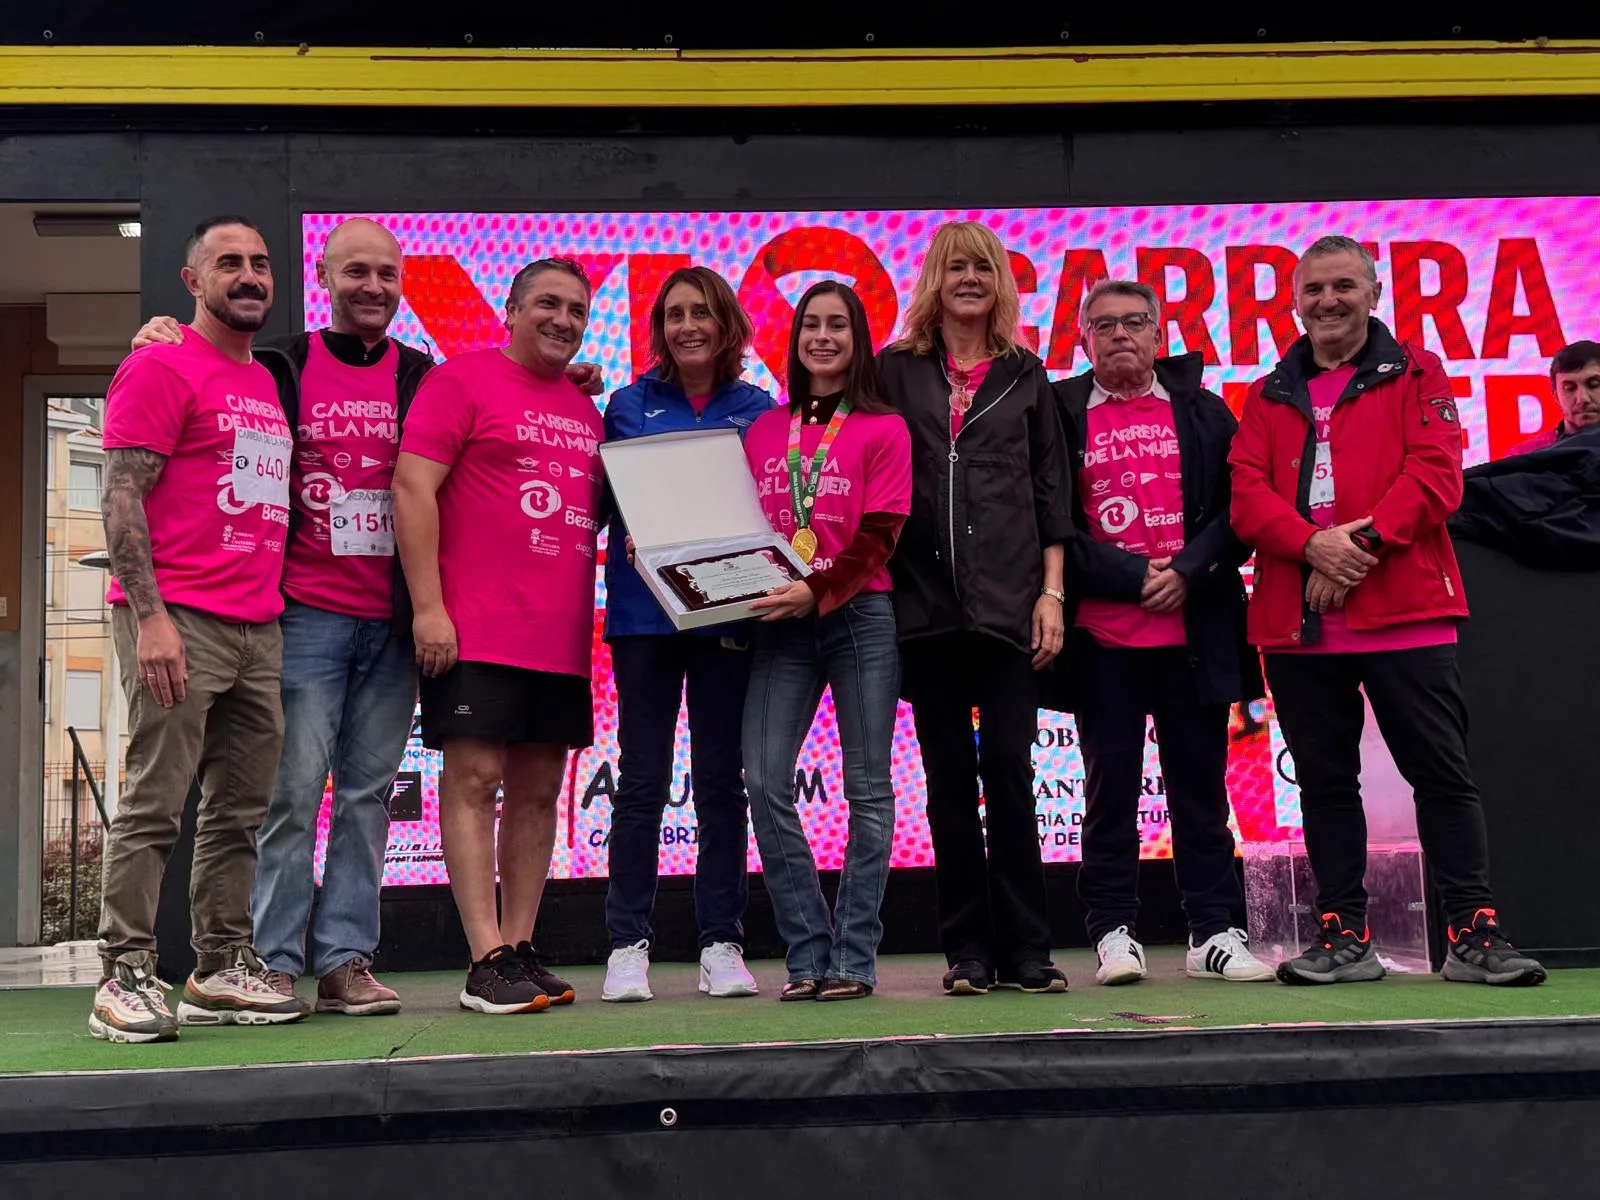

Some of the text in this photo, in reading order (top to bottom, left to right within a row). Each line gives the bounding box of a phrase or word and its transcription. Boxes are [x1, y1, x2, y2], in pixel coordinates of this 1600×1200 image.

[226, 394, 287, 420] CARRERA
[297, 420, 399, 444] DE LA MUJ
[515, 424, 541, 443] DE
[541, 428, 566, 449] LA
[523, 410, 597, 438] CARRERA
[1094, 424, 1177, 446] CARRERA
[1084, 439, 1180, 468] DE LA MUJE
[256, 455, 284, 481] 640
